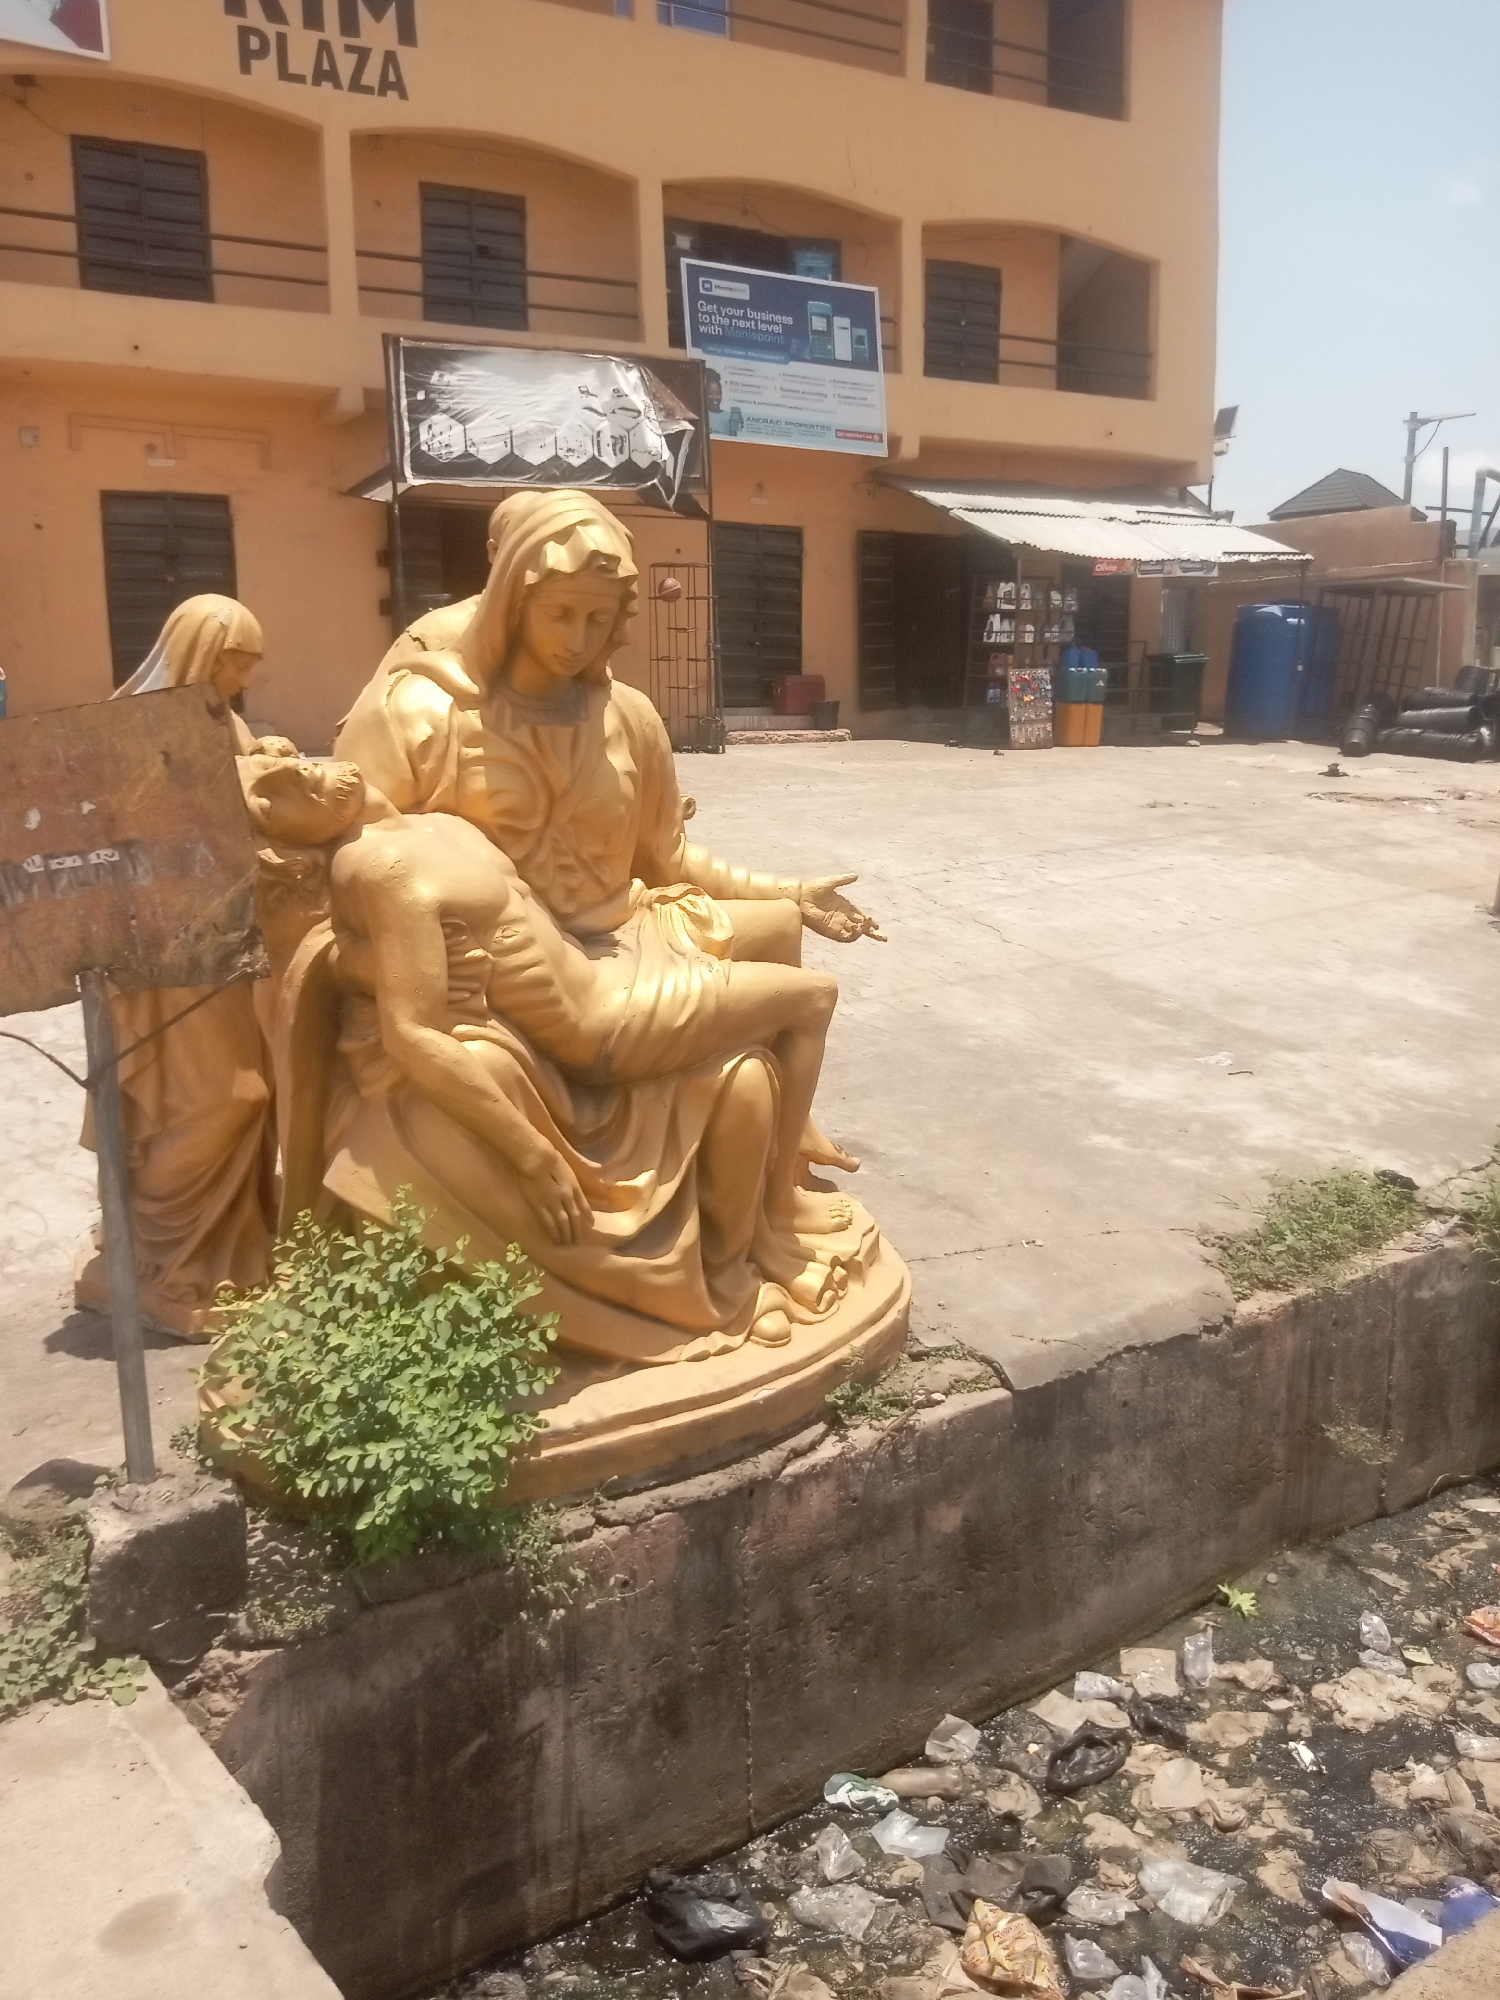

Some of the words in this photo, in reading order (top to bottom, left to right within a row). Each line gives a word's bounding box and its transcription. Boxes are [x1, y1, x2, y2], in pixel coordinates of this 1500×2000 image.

[236, 24, 409, 101] PLAZA
[697, 300, 718, 313] Get
[720, 306, 745, 316] your
[747, 307, 793, 325] business
[698, 312, 709, 323] to
[712, 313, 729, 326] the
[732, 318, 756, 330] next
[757, 320, 782, 334] level
[699, 323, 722, 335] with
[724, 326, 785, 345] Moniepoint
[746, 416, 782, 426] ANDRAZI
[784, 421, 831, 431] PROPERTIES
